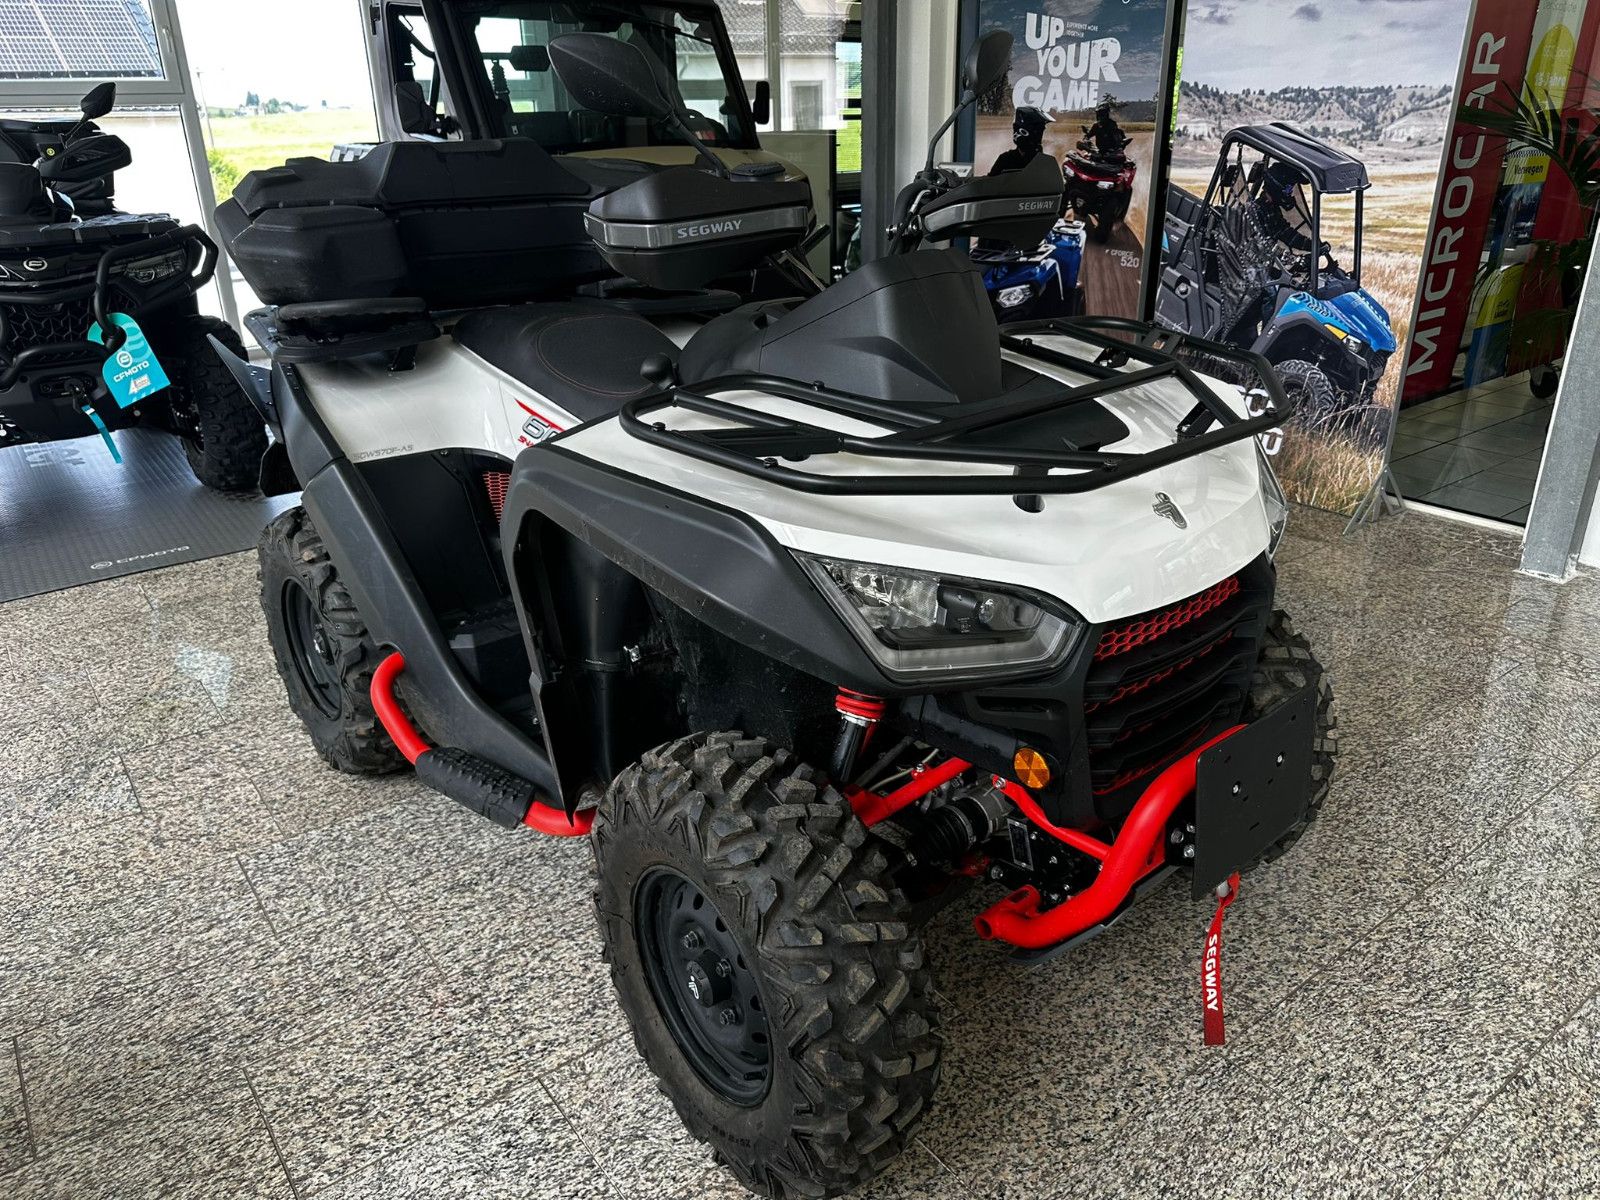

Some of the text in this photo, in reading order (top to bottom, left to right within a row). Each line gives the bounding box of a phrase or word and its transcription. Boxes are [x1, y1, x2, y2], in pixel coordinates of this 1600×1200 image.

[1025, 12, 1065, 50] UP
[1037, 37, 1122, 82] YOUR
[1012, 75, 1099, 112] GAME
[1018, 200, 1055, 211] SEGWAY
[677, 219, 743, 239] SEGWAY
[1120, 256, 1140, 268] 520
[113, 360, 150, 383] CFMOTO
[1205, 933, 1219, 1012] SEGWAY
